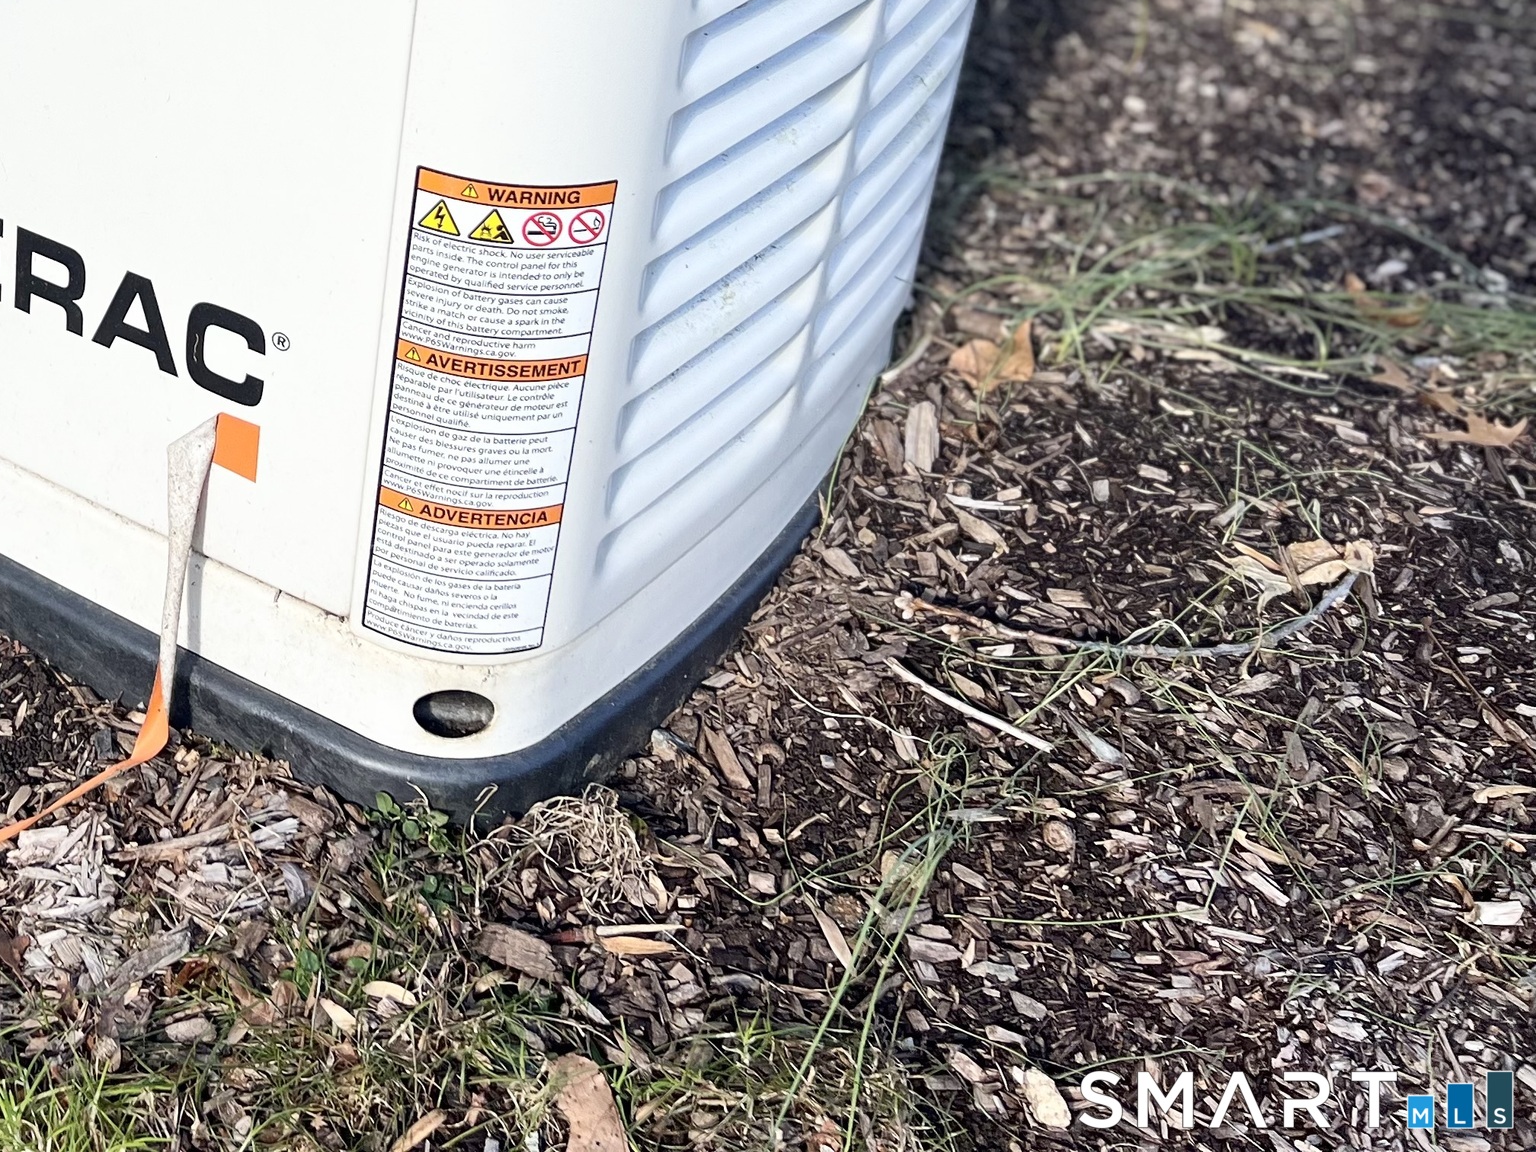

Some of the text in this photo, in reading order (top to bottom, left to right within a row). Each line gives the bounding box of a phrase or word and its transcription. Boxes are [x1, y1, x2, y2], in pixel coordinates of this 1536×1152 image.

[487, 187, 581, 205] WARNING
[412, 244, 434, 255] parts
[467, 256, 484, 266] The
[485, 260, 519, 269] control
[548, 262, 560, 270] for
[562, 261, 578, 269] this
[414, 232, 430, 243] Risk
[443, 242, 476, 254] electric
[510, 251, 524, 259] No
[547, 249, 594, 259] serviceable
[409, 265, 449, 281] operated
[450, 274, 462, 285] by
[464, 279, 505, 290] qualified
[411, 254, 441, 268] engine
[442, 263, 487, 277] generator
[489, 271, 497, 279] is
[499, 272, 541, 281] intended
[553, 272, 572, 280] only
[574, 270, 585, 278] be
[406, 289, 434, 302] severe
[436, 297, 462, 310] injury
[506, 307, 520, 315] Do
[408, 277, 449, 295] Explosion
[463, 292, 496, 304] battery
[543, 297, 568, 305] cause
[404, 309, 434, 323] vicinity
[447, 321, 464, 330] this
[466, 324, 499, 335] battery
[405, 299, 428, 311] strike
[437, 308, 465, 319] match
[479, 316, 505, 325] cause
[551, 317, 566, 325] the
[402, 321, 431, 336] Cancer
[433, 332, 451, 341] and
[452, 336, 510, 349] reproductive
[397, 362, 425, 378] Risque
[427, 372, 438, 381] de
[440, 376, 461, 386] choc
[426, 354, 581, 377] AVERTISSEMENT
[394, 383, 432, 400] panneau
[433, 395, 445, 403] de
[446, 398, 457, 406] ce
[510, 404, 522, 412] de
[523, 403, 554, 411] moteur
[556, 401, 568, 409] est
[437, 386, 453, 394] par
[507, 394, 518, 402] Le
[392, 403, 435, 420] personnel
[481, 414, 535, 422] uniquement
[536, 413, 550, 422] par
[390, 427, 416, 440] causer
[418, 436, 433, 445] des
[435, 440, 476, 453] blessures
[522, 447, 530, 455] la
[391, 416, 437, 435] L'explosion
[438, 430, 450, 439] de
[452, 433, 468, 441] gaz
[469, 435, 481, 443] de
[483, 436, 491, 444] la
[528, 436, 548, 445] peut
[420, 505, 547, 526] ADVERTENCIA
